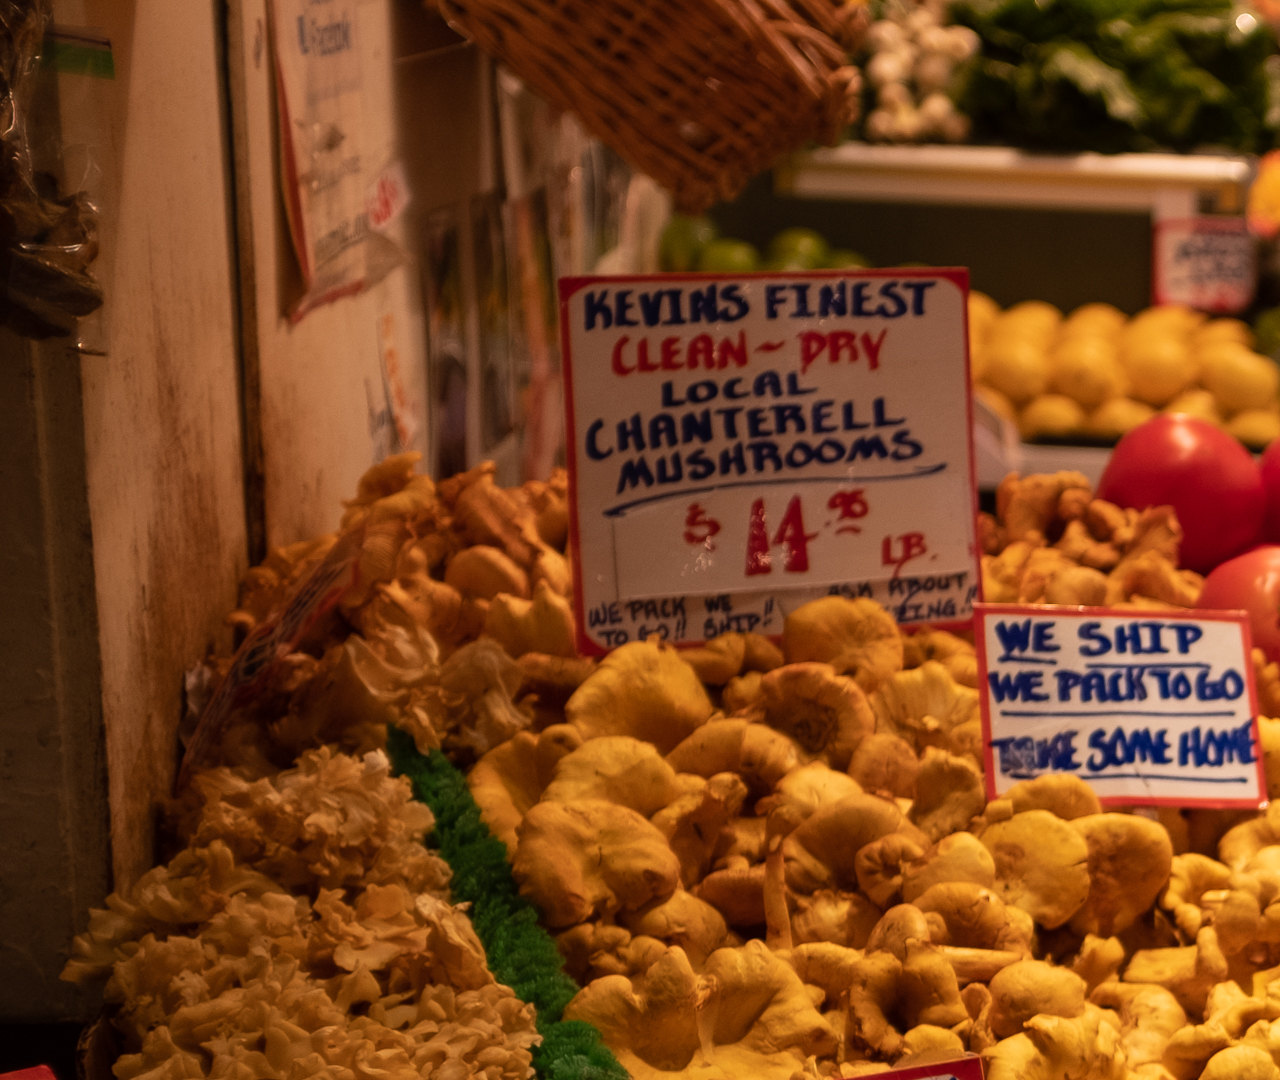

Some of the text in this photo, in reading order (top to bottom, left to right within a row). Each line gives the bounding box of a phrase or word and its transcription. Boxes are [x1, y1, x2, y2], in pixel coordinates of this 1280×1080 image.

[585, 280, 937, 330] KEVINS FINEST
[660, 370, 819, 408] LOCAL
[585, 397, 907, 461] CHANTERELL
[616, 430, 924, 494] MUSHROOMS
[703, 594, 733, 613] WE
[888, 571, 969, 602] ABOUT
[588, 596, 687, 627] WE PACK
[600, 628, 628, 647] TO
[995, 619, 1204, 658] WE SHIP
[987, 667, 1245, 703] WE PACK TO GO
[1087, 726, 1174, 772] SOME
[1178, 717, 1258, 768] HOME
